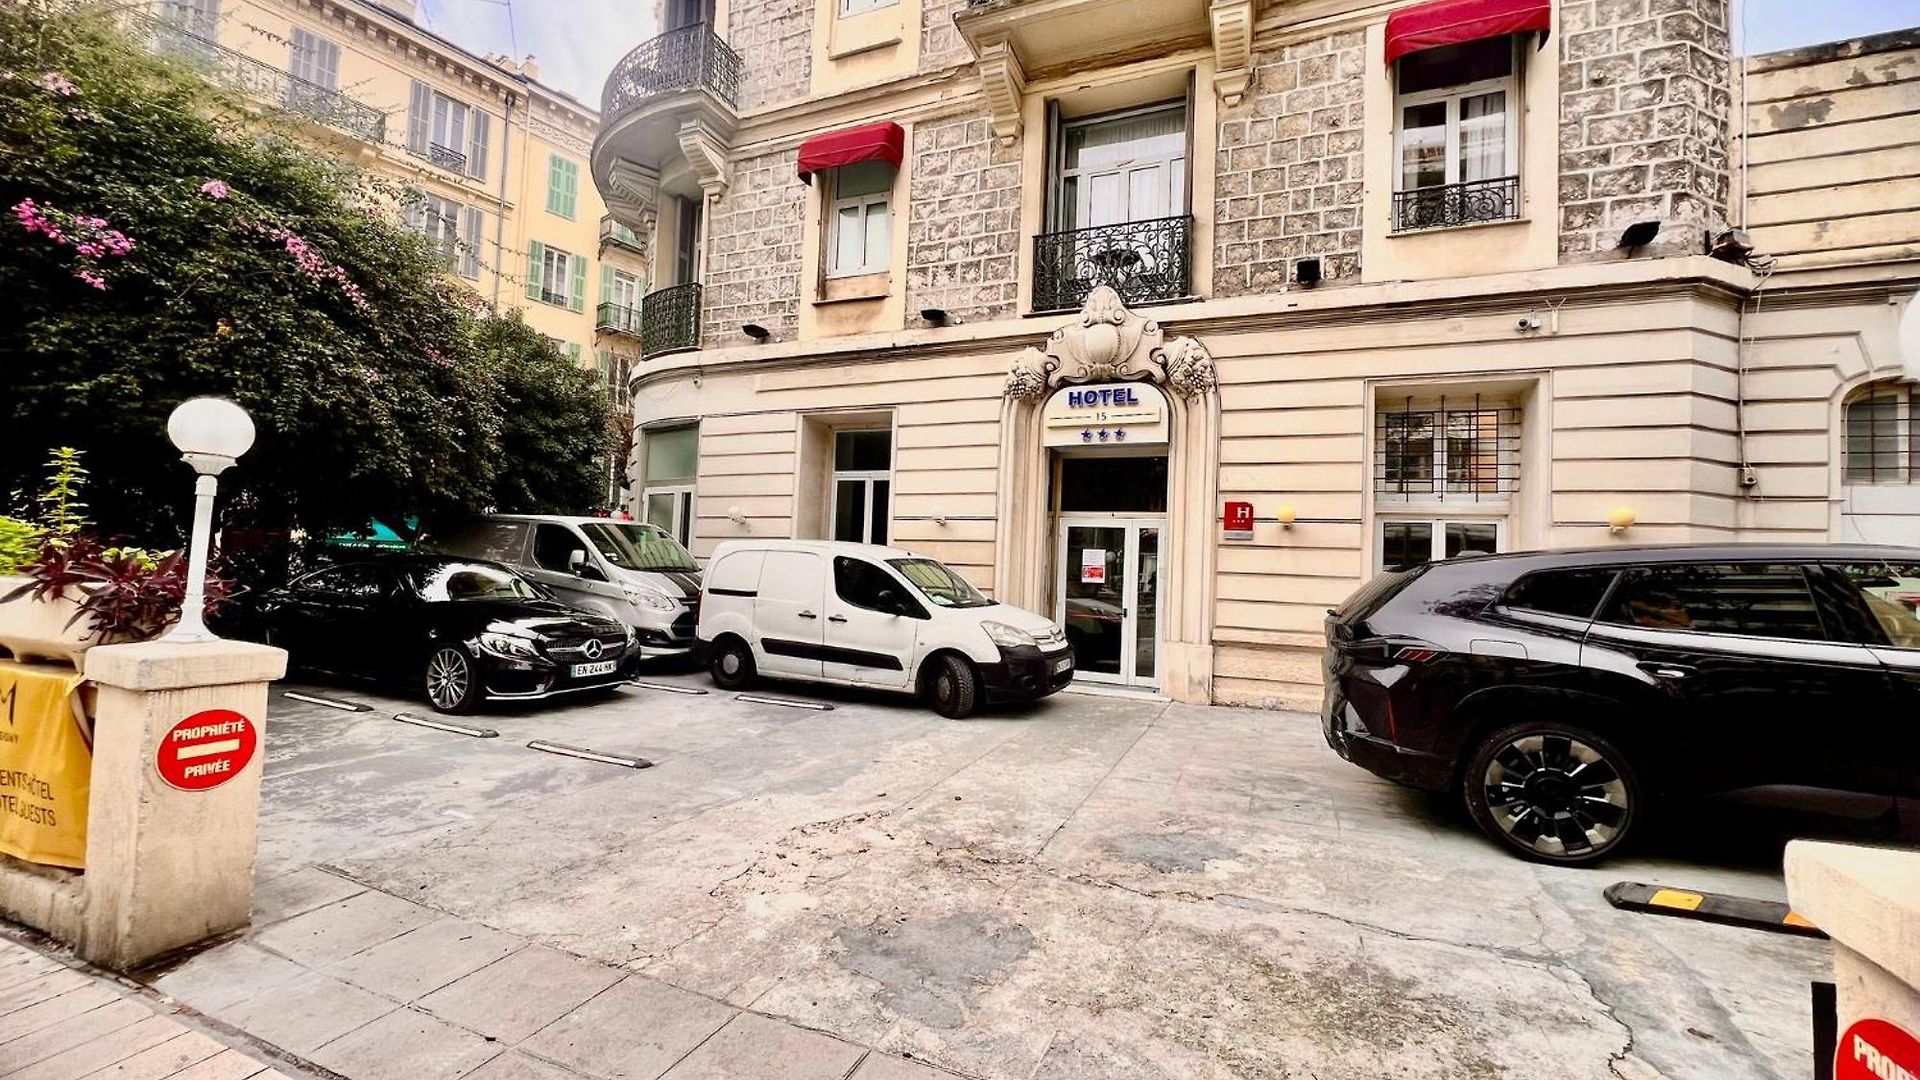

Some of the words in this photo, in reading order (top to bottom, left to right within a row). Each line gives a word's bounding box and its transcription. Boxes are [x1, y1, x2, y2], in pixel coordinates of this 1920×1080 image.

[1068, 388, 1138, 406] HOTEL
[1096, 412, 1107, 421] 15
[1237, 507, 1249, 518] H
[173, 719, 245, 742] PROPRIÉTÉ
[184, 758, 230, 779] PRIVÉE
